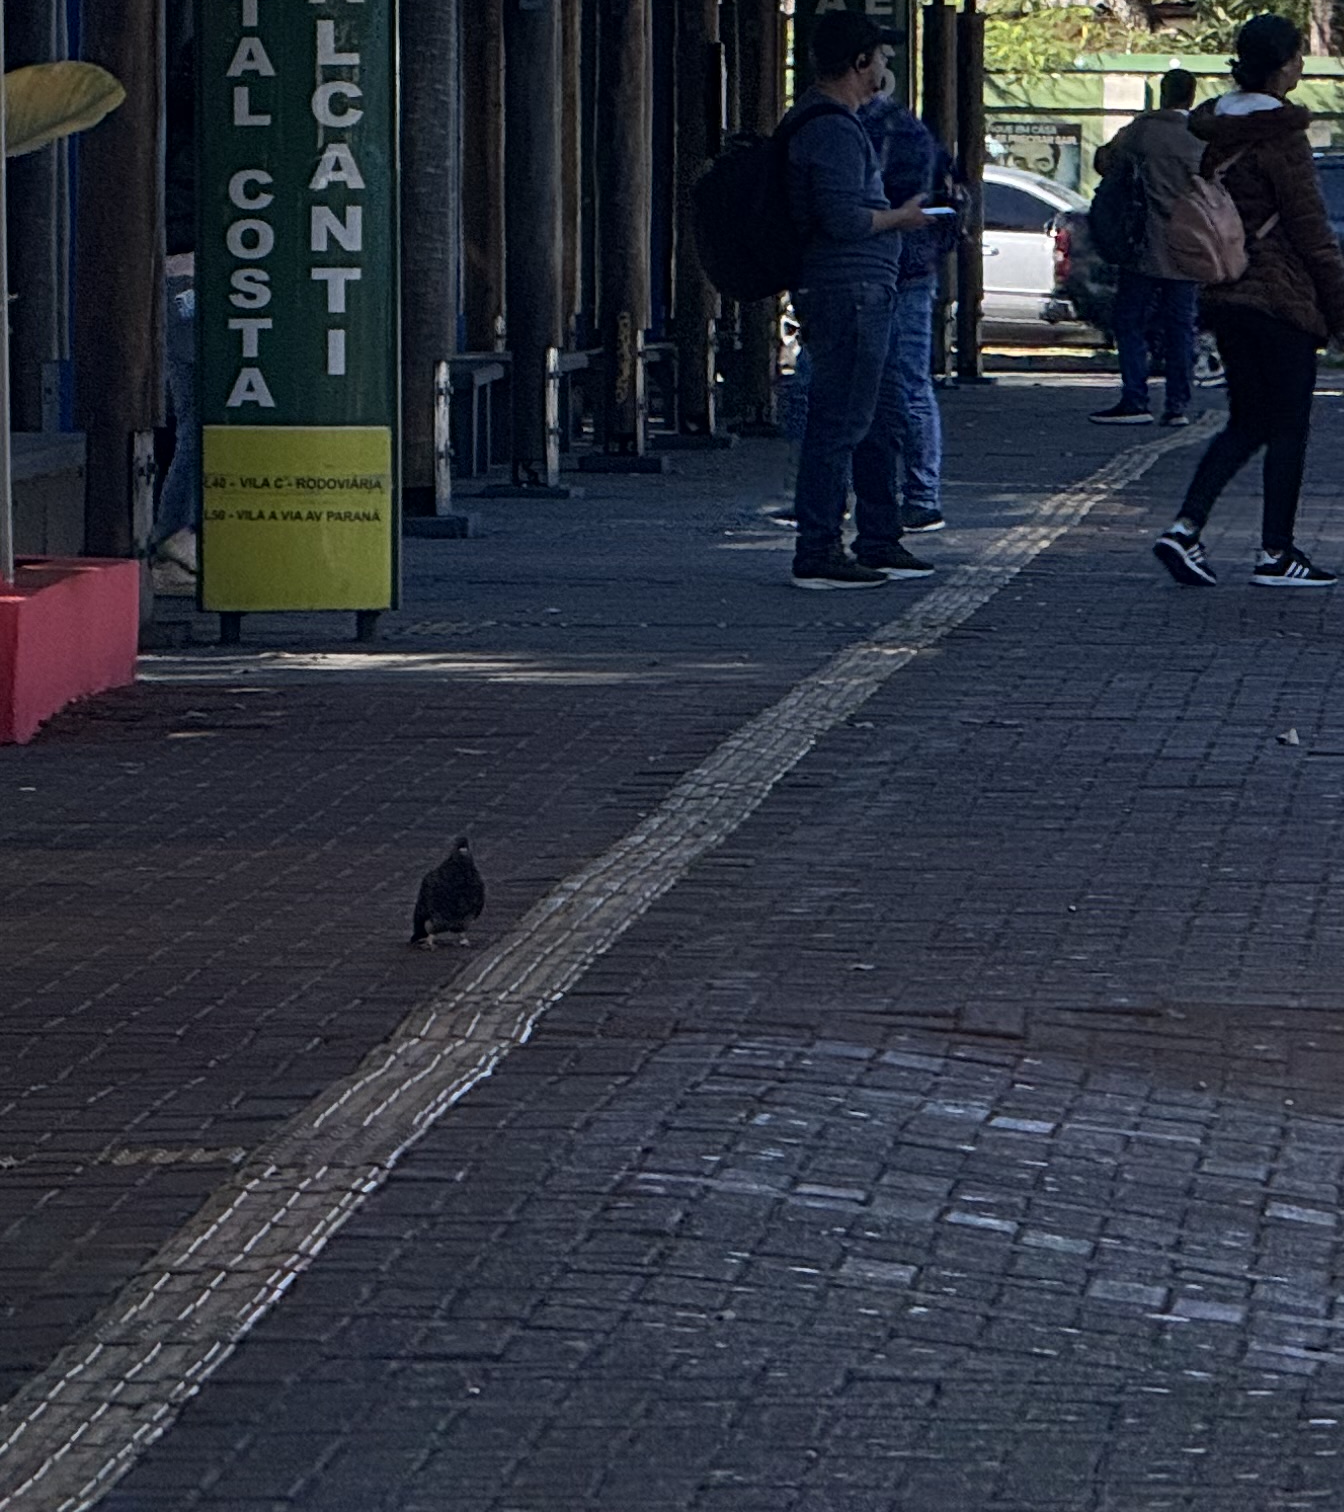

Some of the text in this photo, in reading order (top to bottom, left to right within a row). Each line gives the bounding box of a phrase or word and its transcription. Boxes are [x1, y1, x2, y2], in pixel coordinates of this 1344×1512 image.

[225, 169, 276, 409] COSTA
[240, 476, 270, 489] VILA
[274, 477, 284, 489] C
[237, 509, 265, 521] VILA
[269, 509, 278, 521] A
[282, 509, 302, 521] VIA
[305, 509, 323, 521] AV
